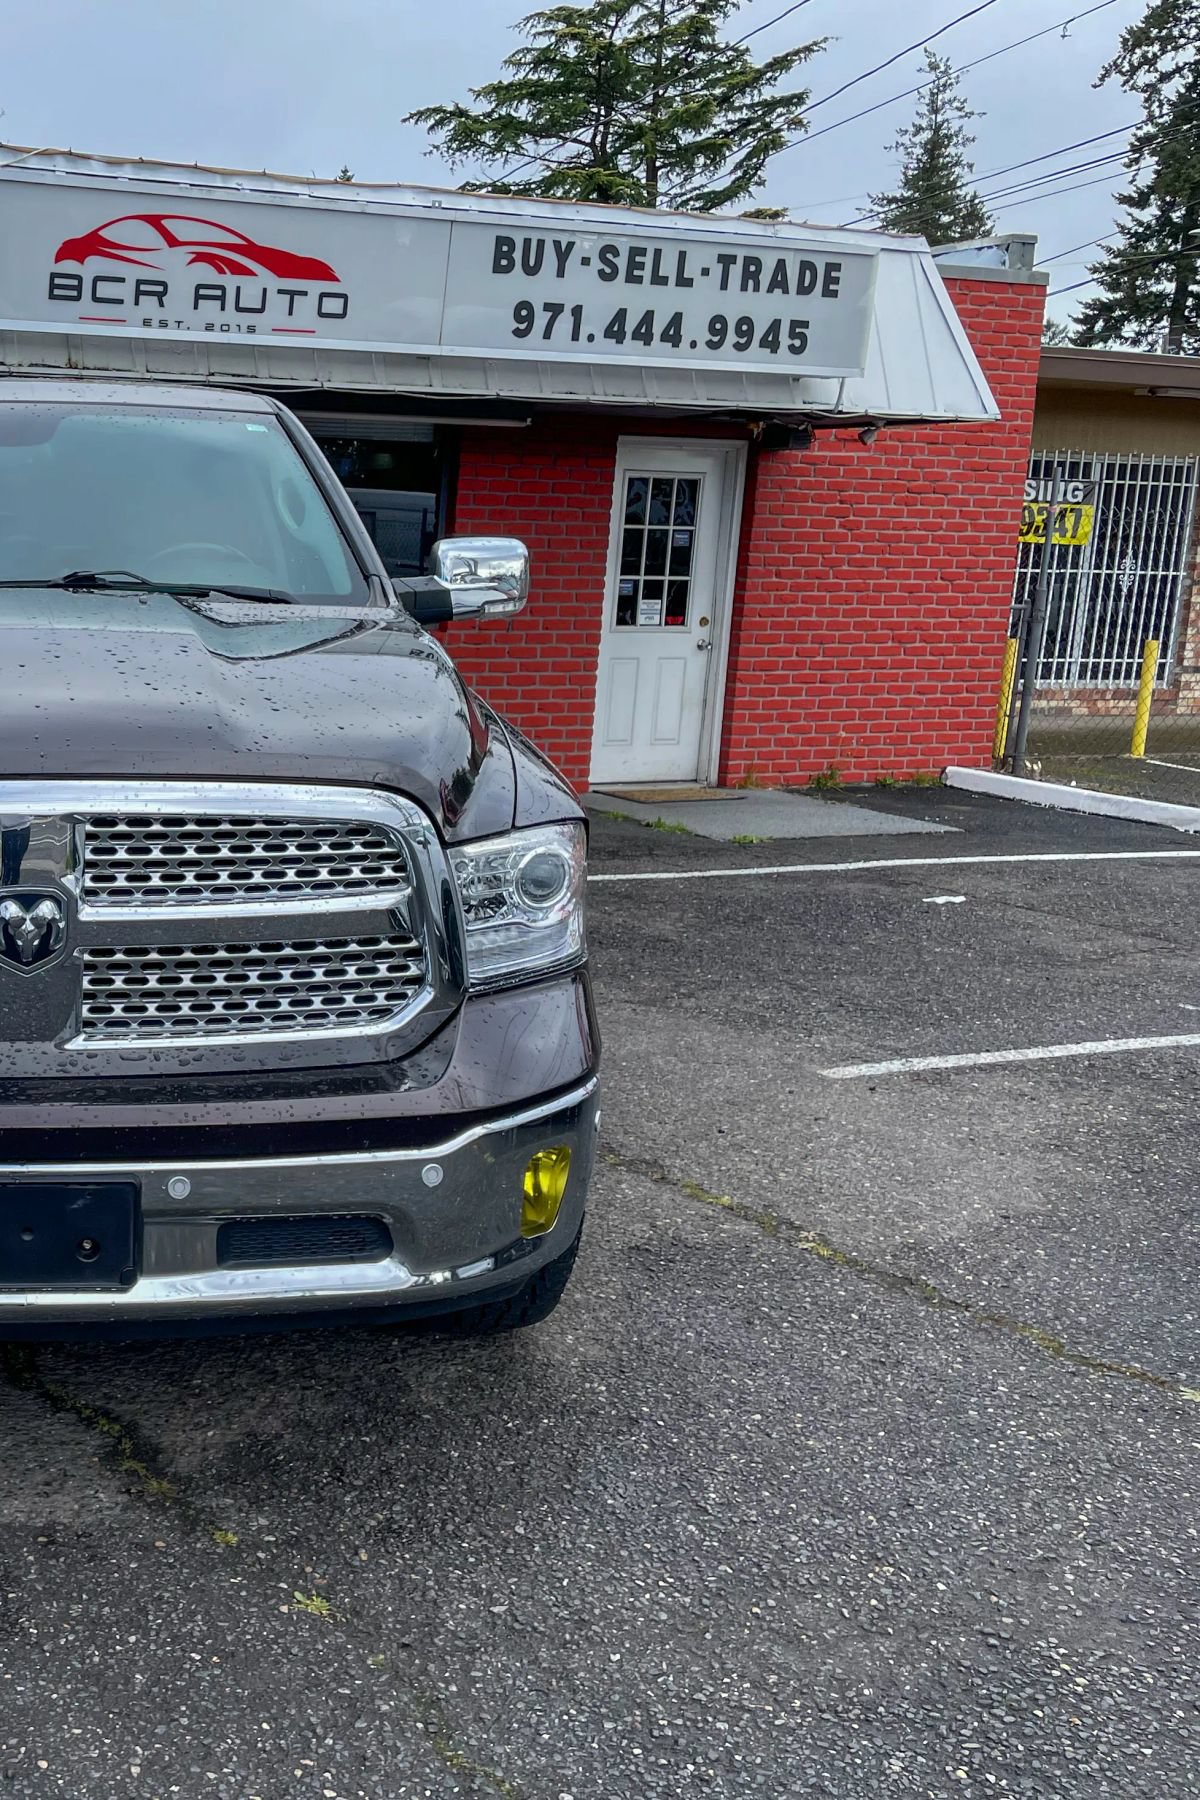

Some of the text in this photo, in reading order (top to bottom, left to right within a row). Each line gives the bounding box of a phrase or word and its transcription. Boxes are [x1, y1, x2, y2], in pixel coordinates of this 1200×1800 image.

[48, 271, 349, 320] BCR AUTO
[142, 318, 258, 333] EST. 2015
[511, 300, 810, 355] 971.444.9945
